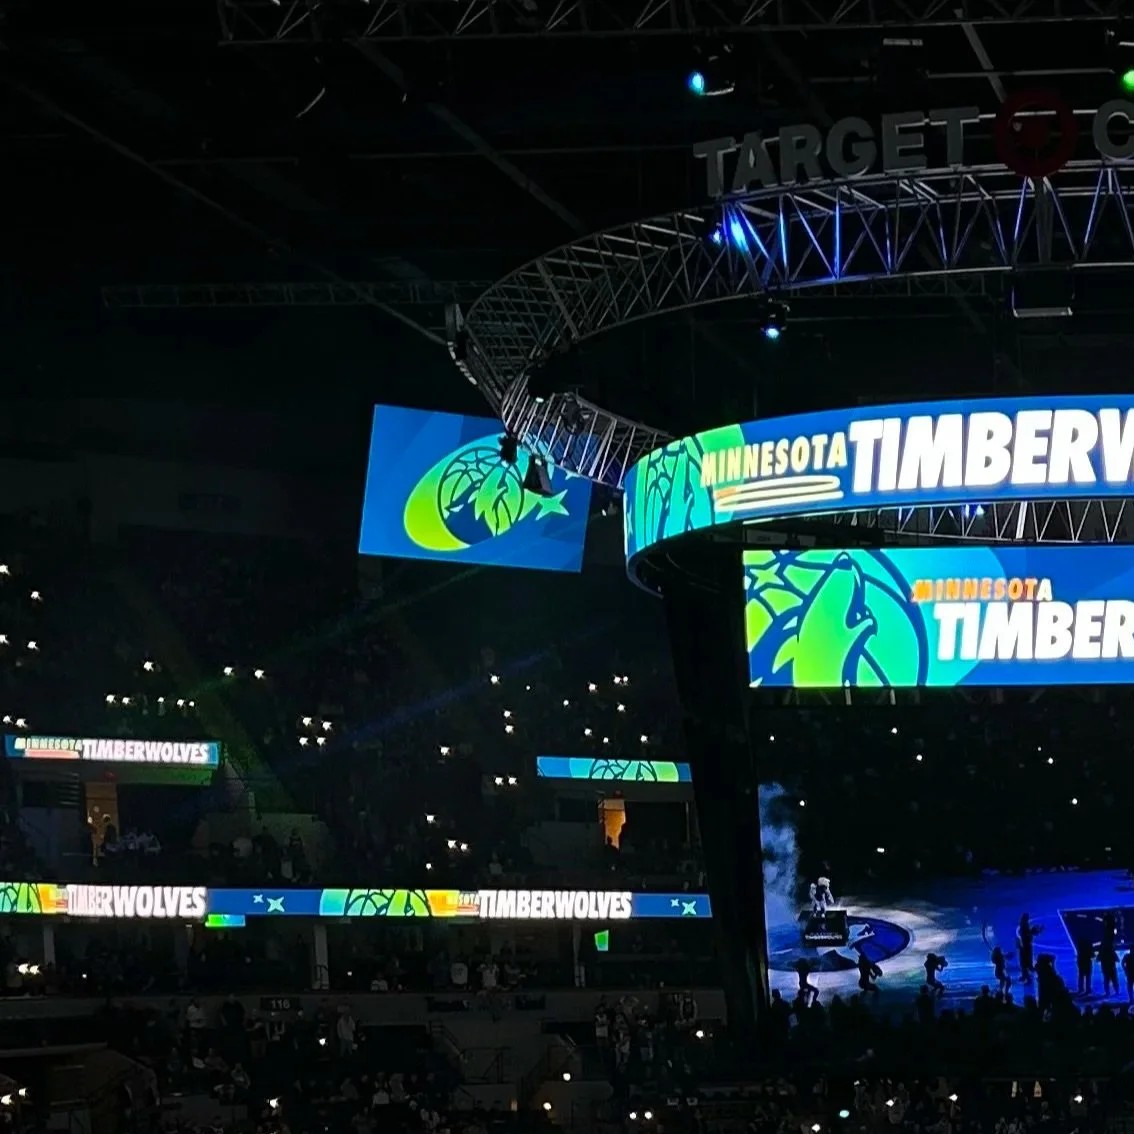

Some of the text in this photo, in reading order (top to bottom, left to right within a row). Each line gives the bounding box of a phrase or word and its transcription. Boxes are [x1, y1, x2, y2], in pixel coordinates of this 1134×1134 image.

[693, 106, 980, 198] TARGET
[699, 430, 849, 490] MINNESOTA
[911, 578, 1053, 602] MINNESOTA
[82, 739, 209, 764] TIMBERWOLVES
[66, 884, 207, 918] TIMBERWOLVES
[478, 889, 632, 919] TIMBERWOLVES
